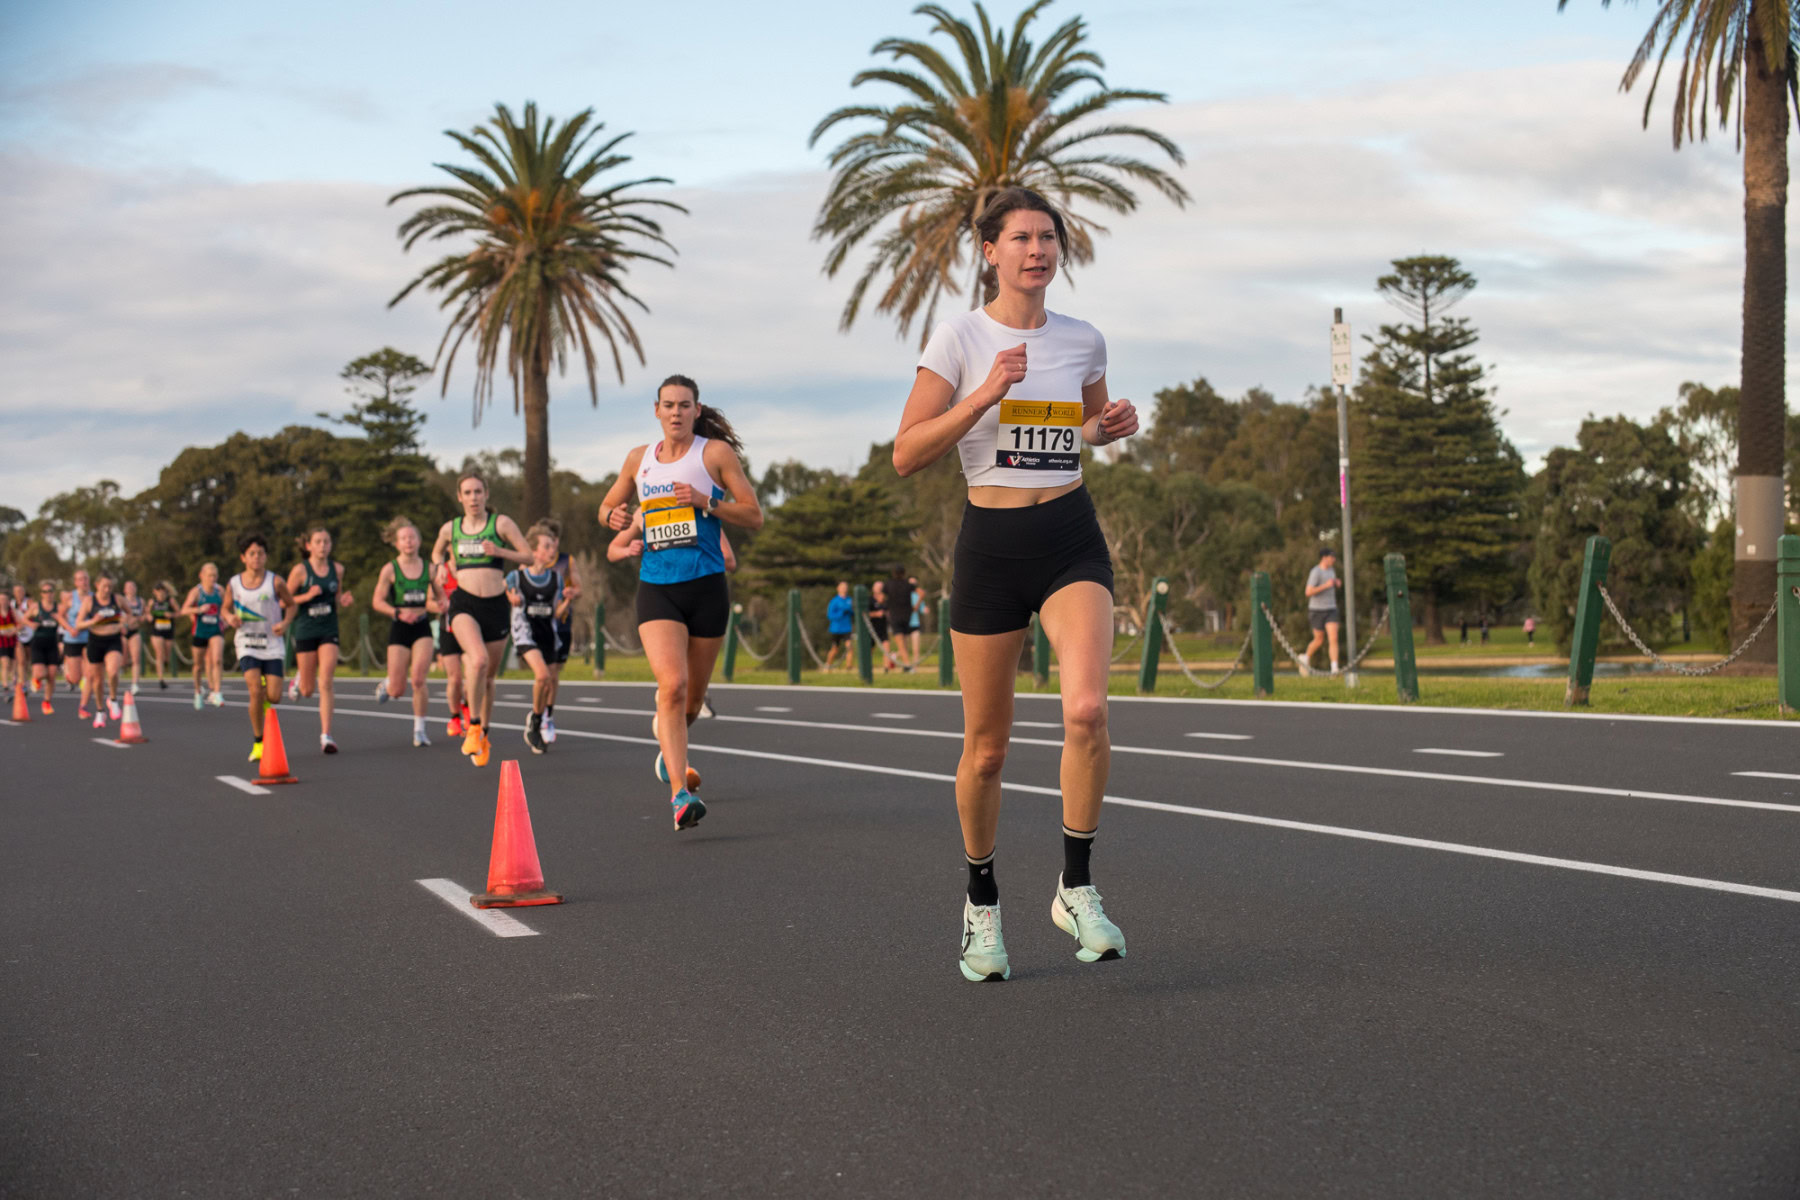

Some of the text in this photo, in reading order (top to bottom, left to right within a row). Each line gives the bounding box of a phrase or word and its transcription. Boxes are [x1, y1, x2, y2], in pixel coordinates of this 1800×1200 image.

[1053, 408, 1076, 416] WORLD
[1011, 426, 1074, 451] 11179
[650, 523, 691, 540] 11088
